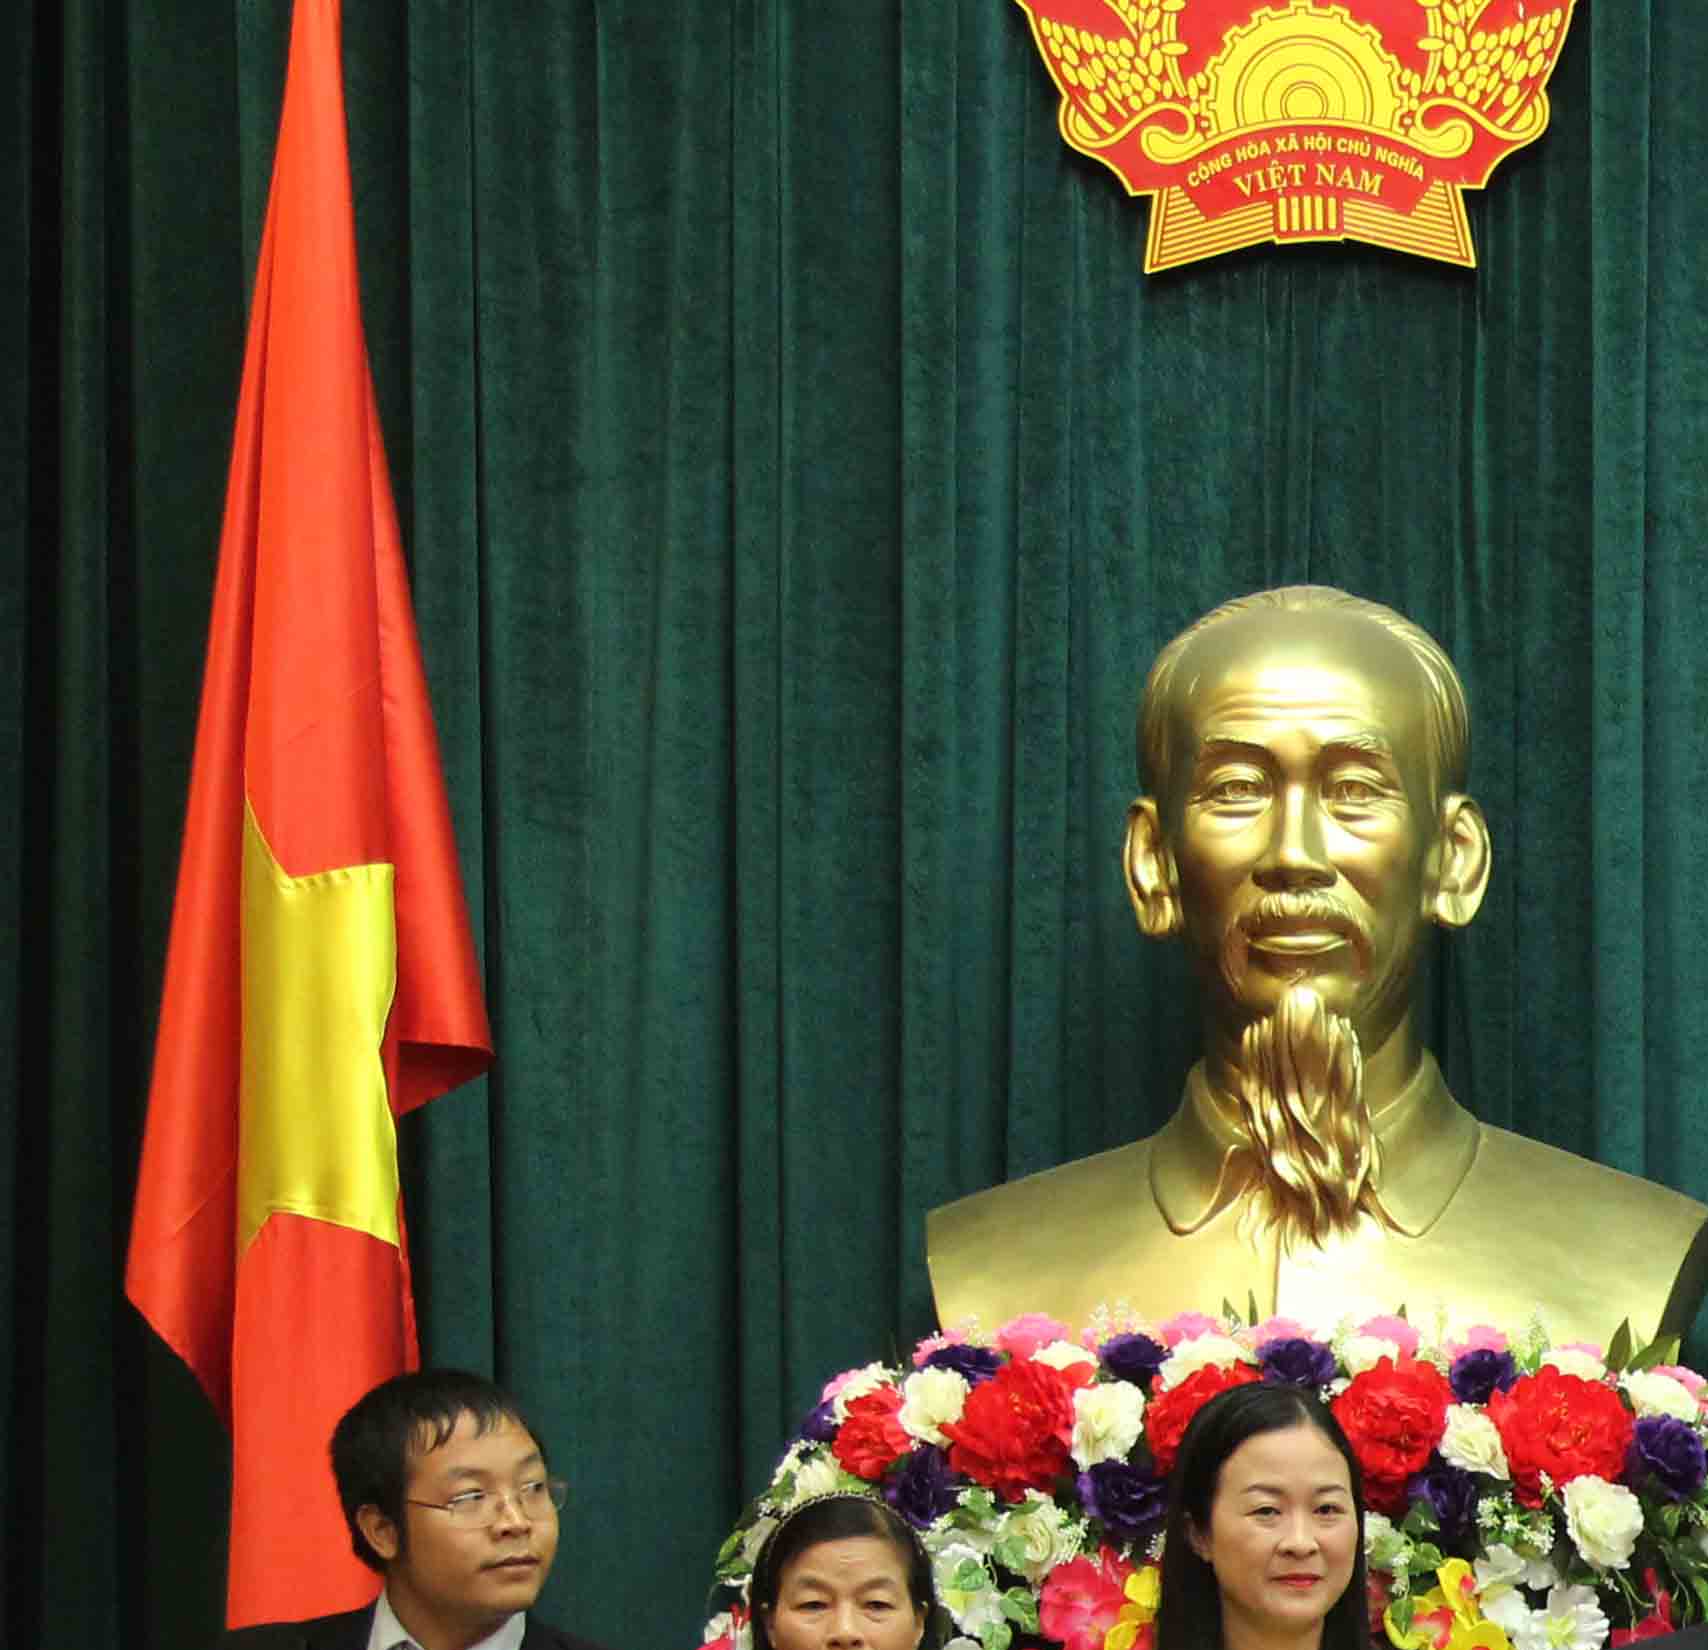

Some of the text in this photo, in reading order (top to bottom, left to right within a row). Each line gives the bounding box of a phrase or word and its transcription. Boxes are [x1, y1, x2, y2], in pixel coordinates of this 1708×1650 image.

[1187, 131, 1425, 187] CỘNG HÒA XÃ HỘI CHỦ NGHĨA
[1232, 160, 1384, 197] VIỆT NAM
